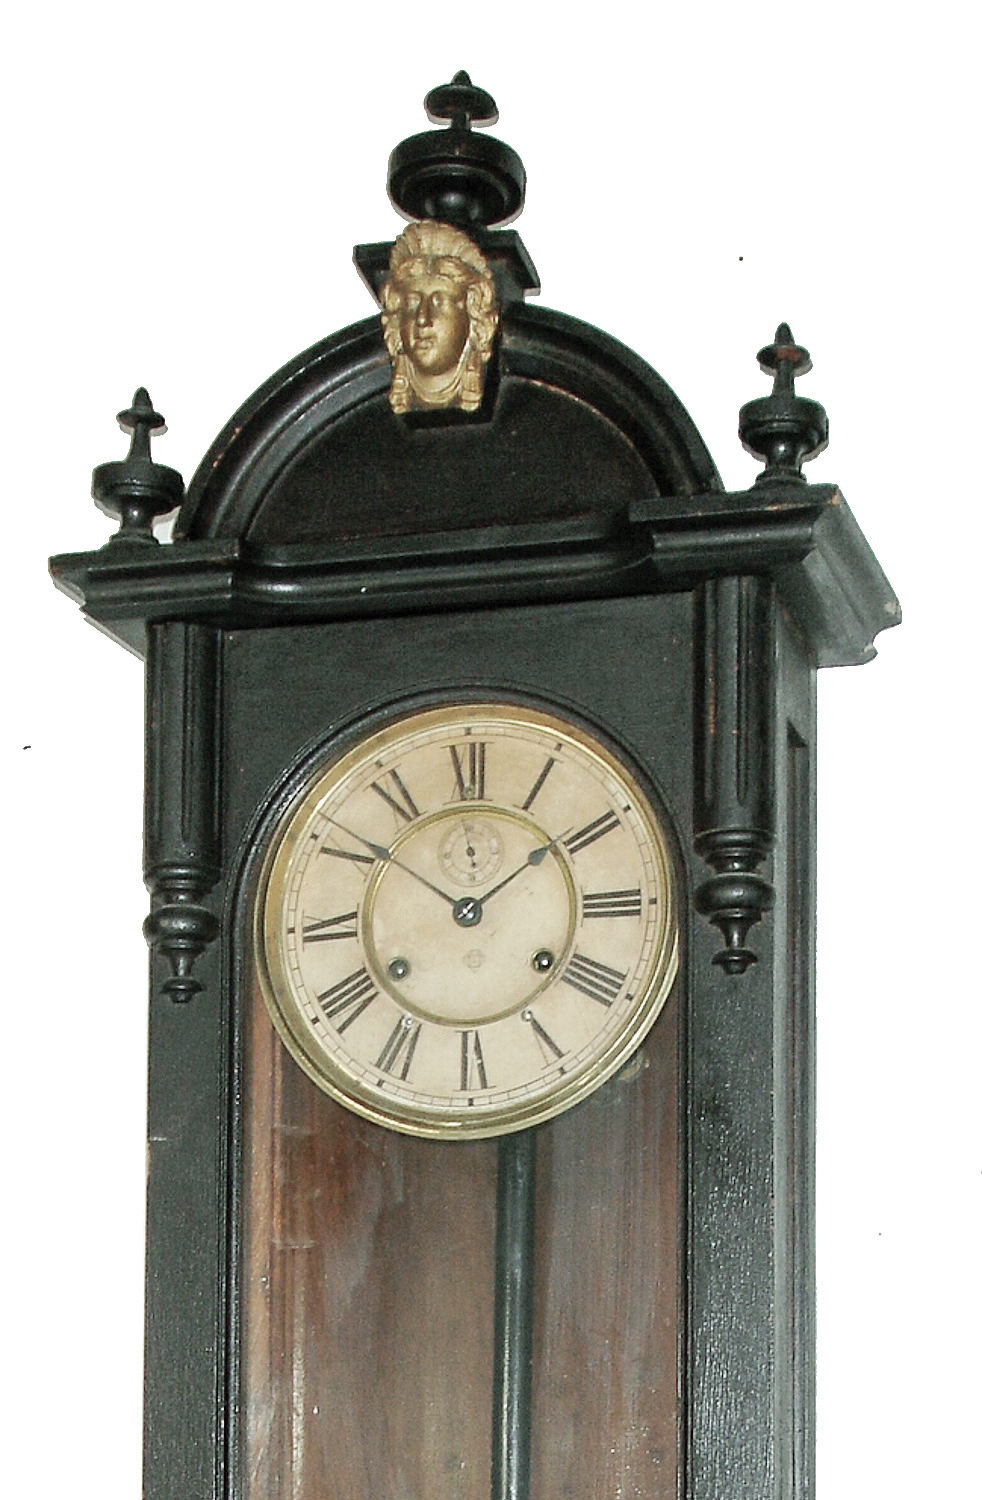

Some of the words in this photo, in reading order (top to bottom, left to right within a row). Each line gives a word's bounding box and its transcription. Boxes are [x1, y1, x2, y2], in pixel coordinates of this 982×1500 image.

[363, 763, 428, 835] XI
[440, 741, 495, 806] XII
[513, 753, 563, 815] I
[316, 827, 376, 883] X
[556, 801, 625, 864] II
[302, 902, 360, 952] IX
[581, 880, 642, 927] III
[313, 961, 379, 1042] VIII
[554, 944, 630, 1014] IIII
[369, 1015, 422, 1084] VII
[453, 1029, 496, 1092] VI
[529, 1018, 571, 1070] V
